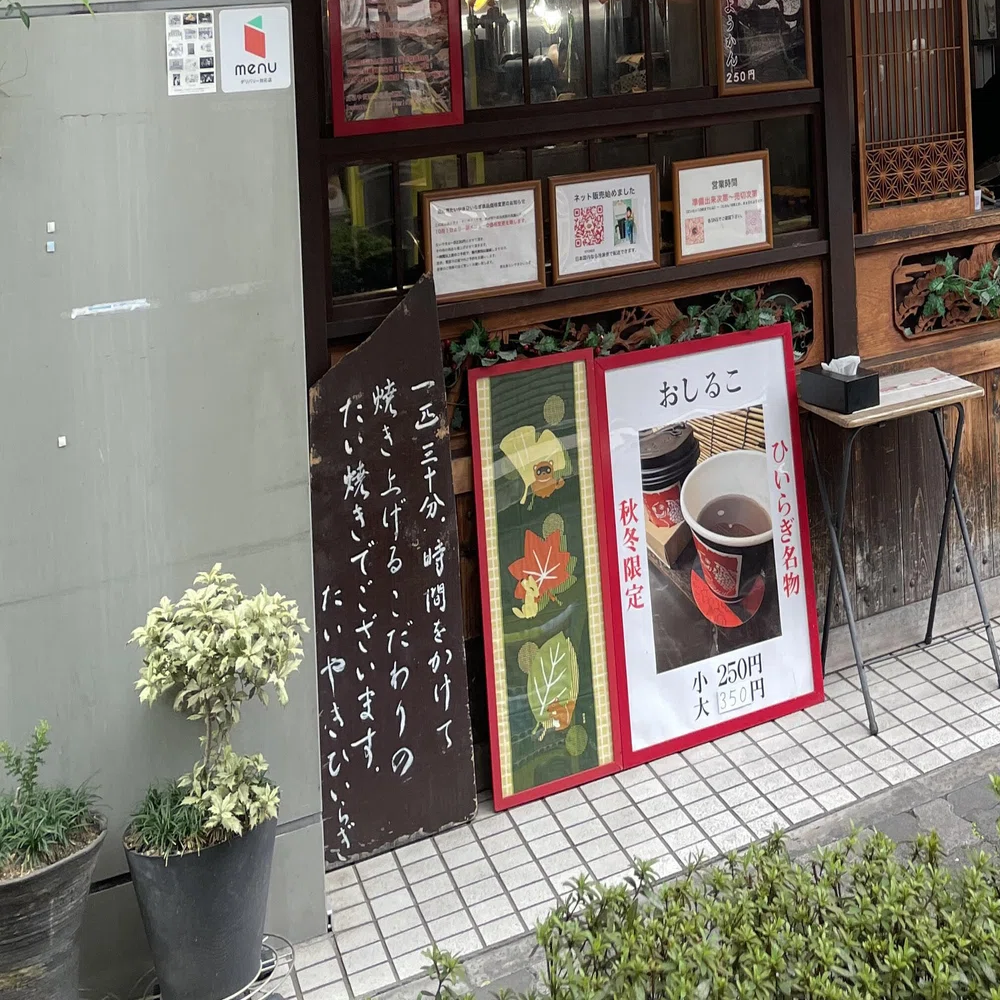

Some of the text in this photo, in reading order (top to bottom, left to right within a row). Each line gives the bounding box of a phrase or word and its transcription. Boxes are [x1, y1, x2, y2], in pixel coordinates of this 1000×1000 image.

[235, 62, 277, 76] menu
[726, 69, 756, 83] 250円
[574, 187, 635, 202] ネット販売始めました
[711, 177, 738, 190] 営業時間
[658, 368, 743, 408] おしるこ
[770, 439, 801, 598] ひいらぎ名物
[617, 497, 645, 612] 秋冬限定
[692, 652, 763, 695] 小 250円
[694, 676, 766, 722] 大 350円
